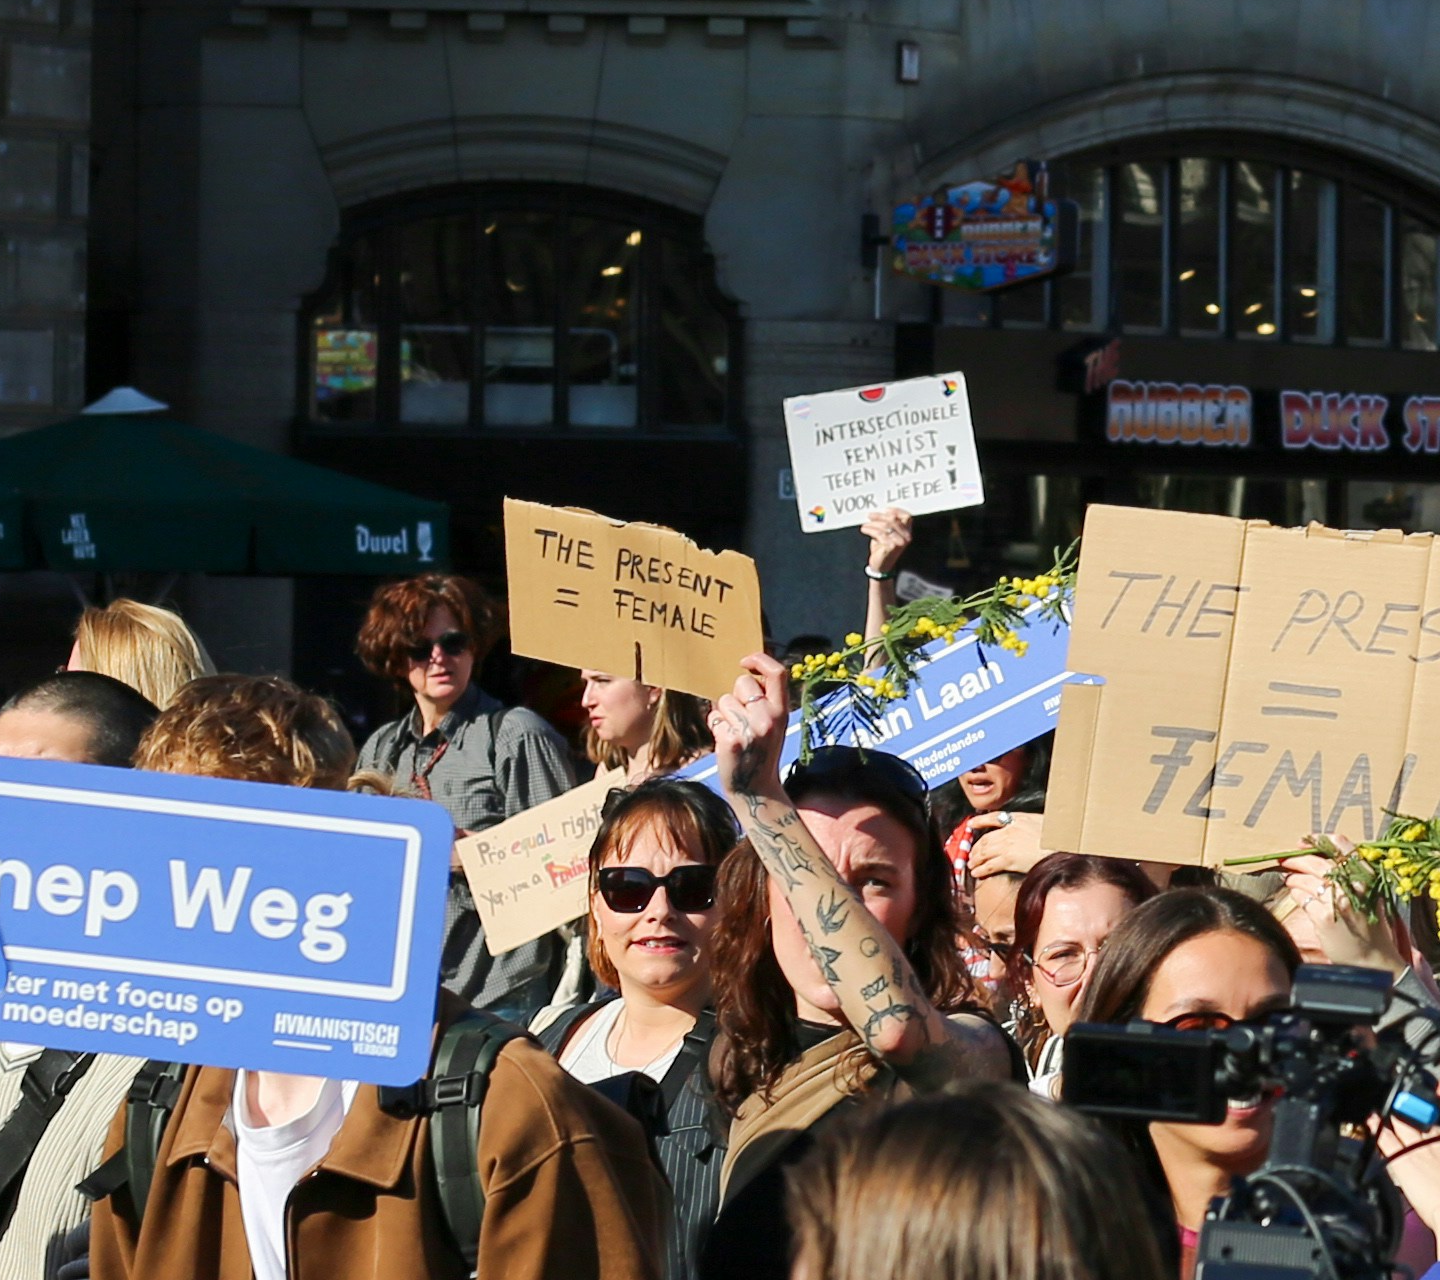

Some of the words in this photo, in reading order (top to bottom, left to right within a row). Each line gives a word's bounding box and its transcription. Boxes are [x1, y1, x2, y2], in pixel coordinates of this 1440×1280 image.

[1108, 380, 1252, 447] RUBBER
[1280, 390, 1389, 451] DUCK
[823, 466, 878, 493] TEGEN
[887, 452, 937, 480] HAAT
[832, 492, 879, 517] VOOR
[355, 523, 409, 555] Duvel
[533, 527, 595, 572] THE
[613, 546, 735, 607] PRESENT
[613, 587, 717, 639] FEMALE
[1101, 570, 1250, 639] THE
[915, 661, 1005, 722] Laan
[913, 728, 986, 771] Nederlandse
[476, 840, 507, 866] Pro
[168, 858, 355, 965] Weg
[52, 976, 110, 1006] met
[116, 979, 199, 1015] focus
[205, 992, 244, 1022] op
[2, 1000, 199, 1048] moederschap
